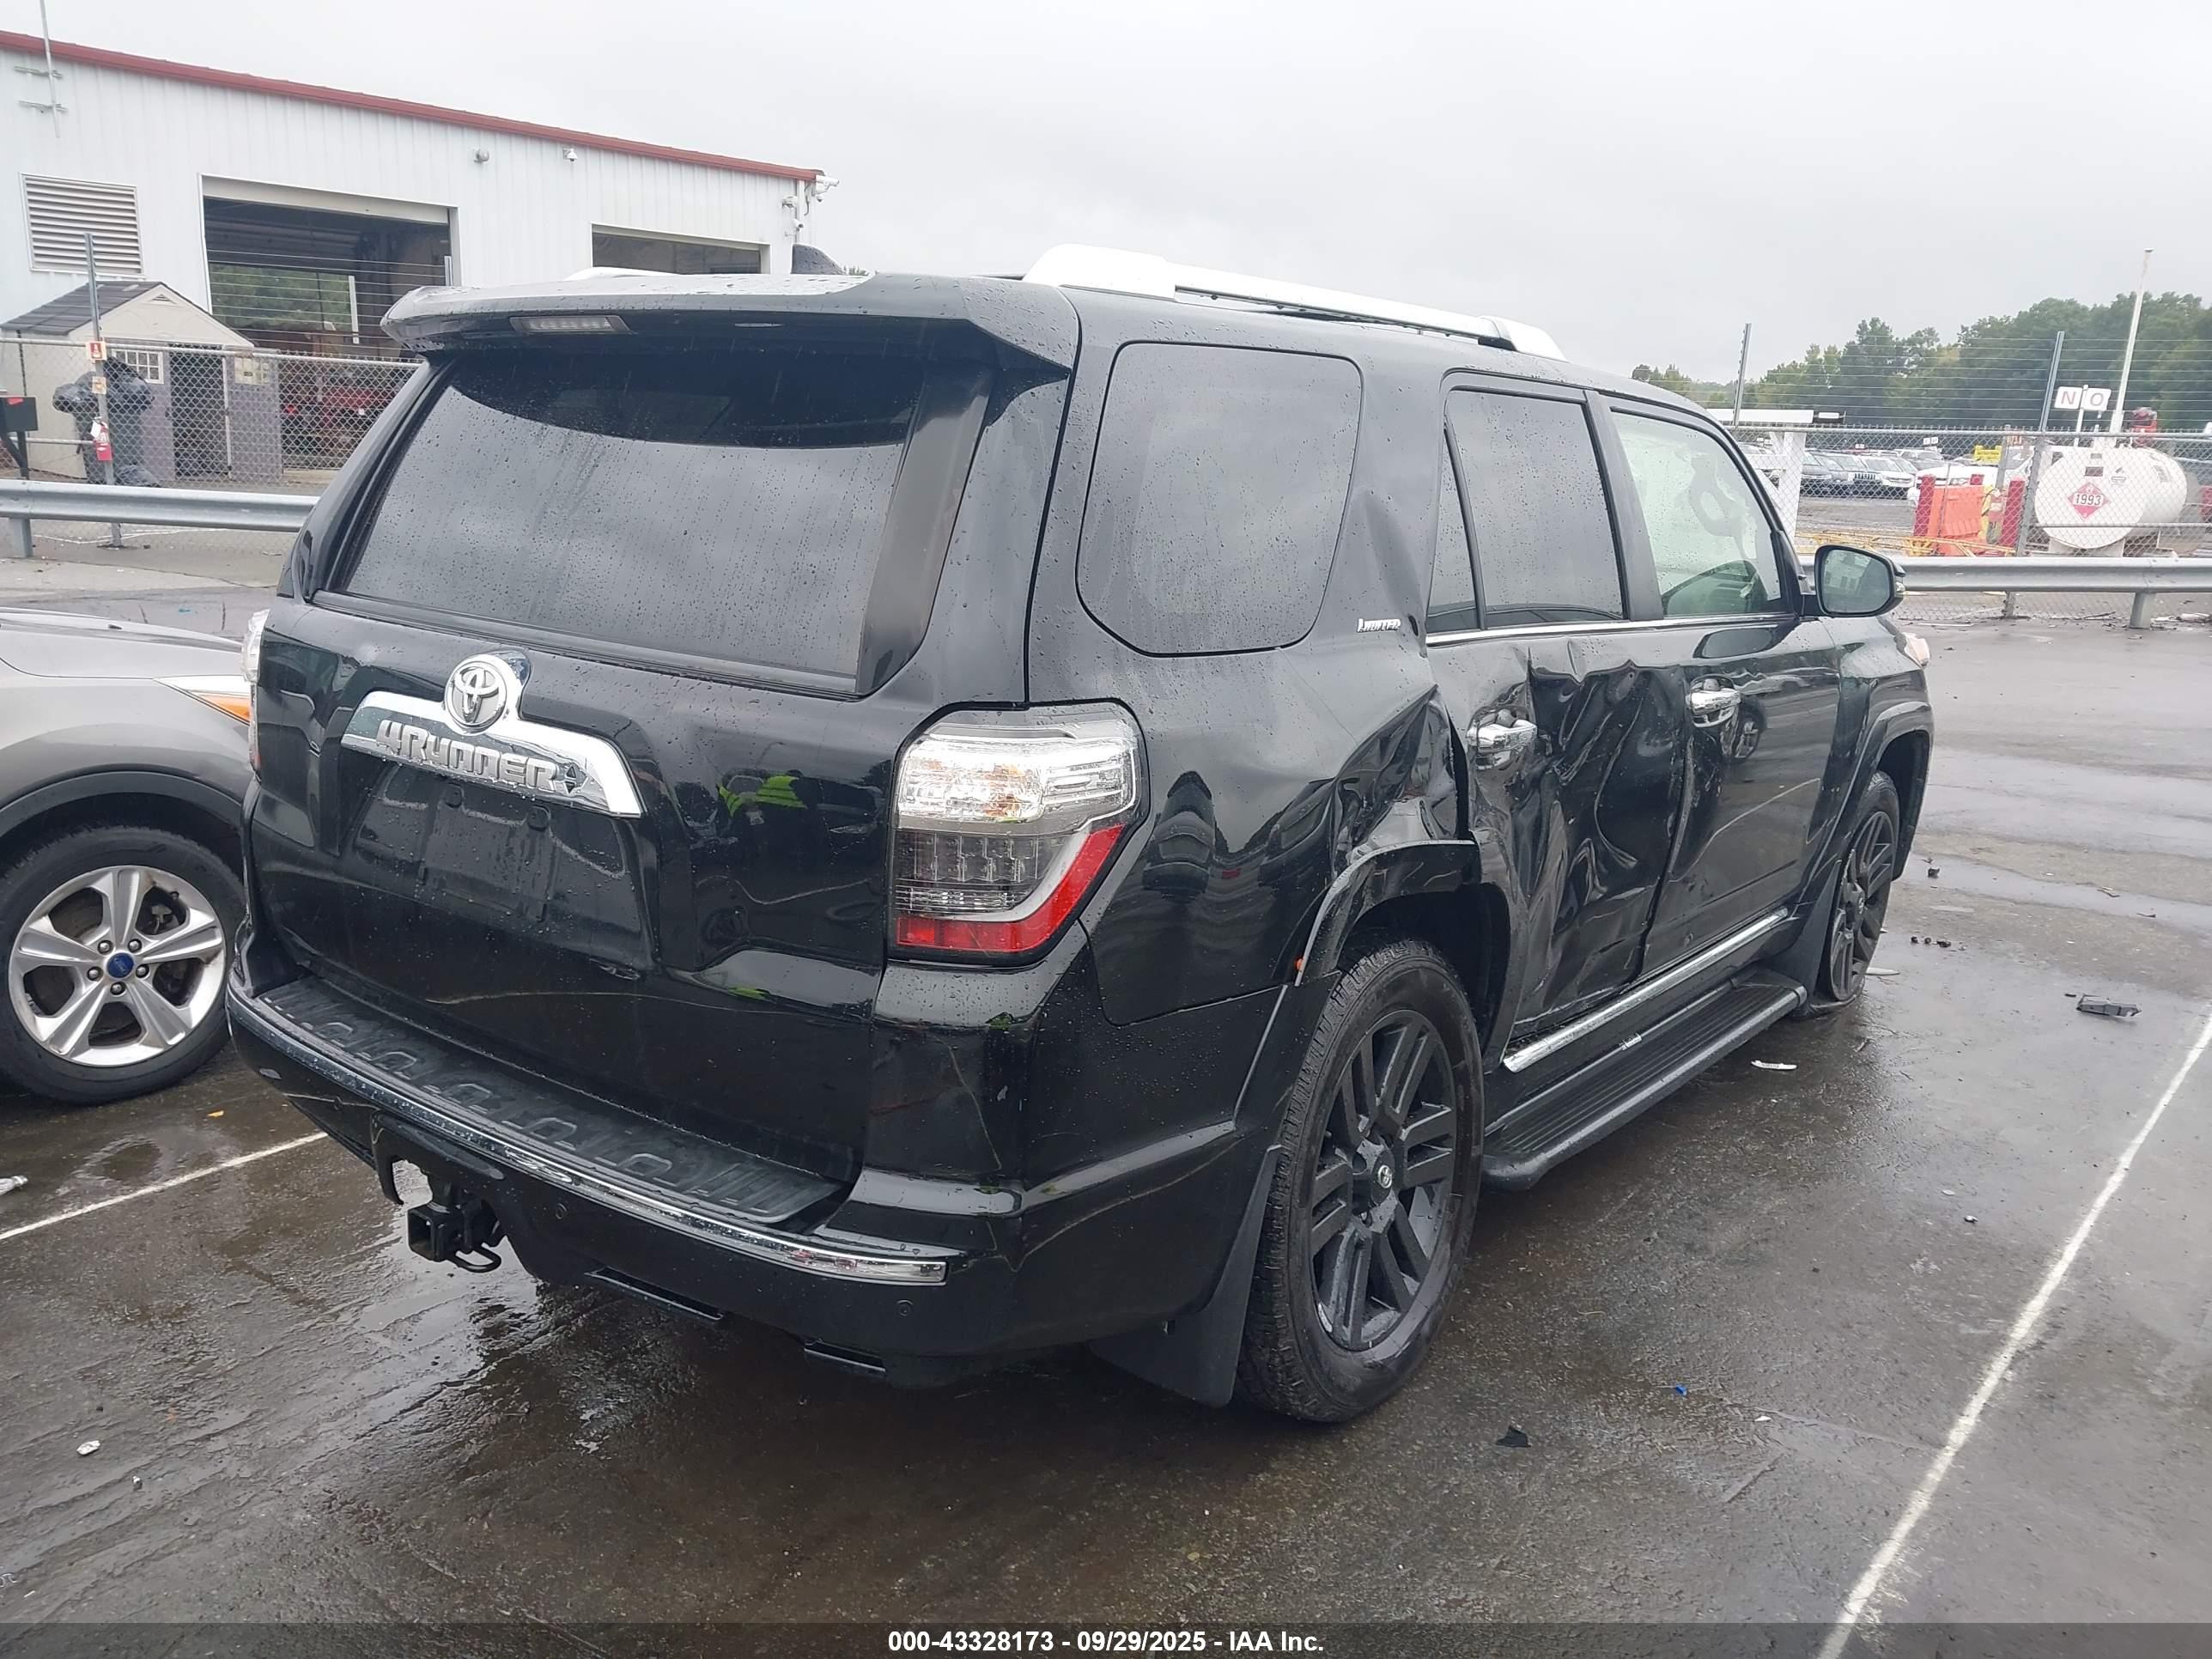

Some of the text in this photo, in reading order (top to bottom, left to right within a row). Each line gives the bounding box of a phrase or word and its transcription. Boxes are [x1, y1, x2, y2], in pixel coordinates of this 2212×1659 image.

[2060, 391, 2076, 405] N
[2075, 494, 2102, 507] 1993
[376, 719, 561, 792] 4RUNNER
